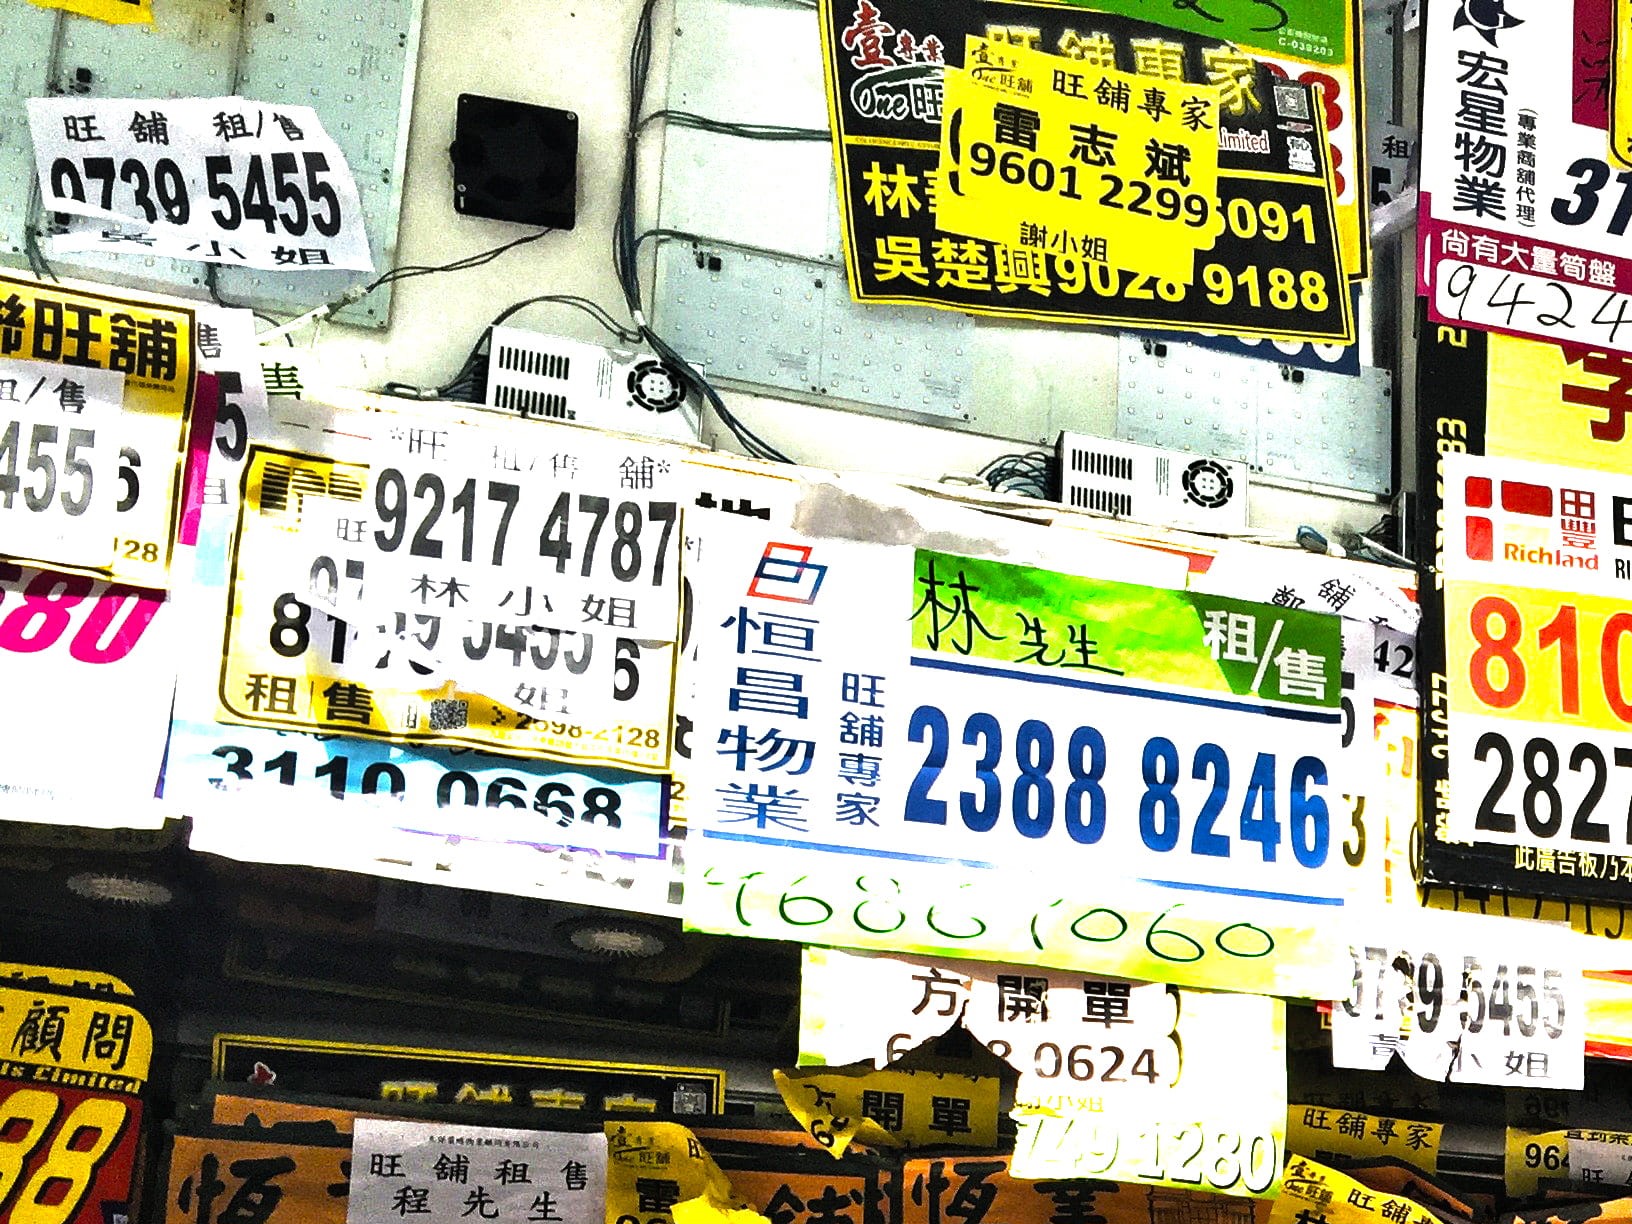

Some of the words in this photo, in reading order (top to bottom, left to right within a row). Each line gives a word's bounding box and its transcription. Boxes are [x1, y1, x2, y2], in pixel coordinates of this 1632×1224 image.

[991, 101, 1193, 188] 雷志斌
[1052, 69, 1215, 134] 旺舖專家
[1452, 48, 1510, 222] 宏星物業
[206, 152, 342, 237] 5455
[968, 139, 1084, 201] 9601
[1098, 173, 1211, 229] 2299
[1018, 220, 1109, 264] 謝小姐
[1205, 268, 1331, 312] 9188
[374, 467, 519, 567] 9217
[539, 489, 678, 587] 4787
[1503, 542, 1600, 572] Richland
[906, 559, 1126, 678] 林先生
[1201, 608, 1331, 701] 租/售
[714, 604, 826, 834] 恒昌物業
[834, 670, 887, 829] 旺舖專家
[902, 703, 1109, 845] 2388
[1137, 734, 1332, 870] 8246
[367, 1152, 590, 1192] 旺舖租售
[391, 1185, 565, 1224] 程先生
